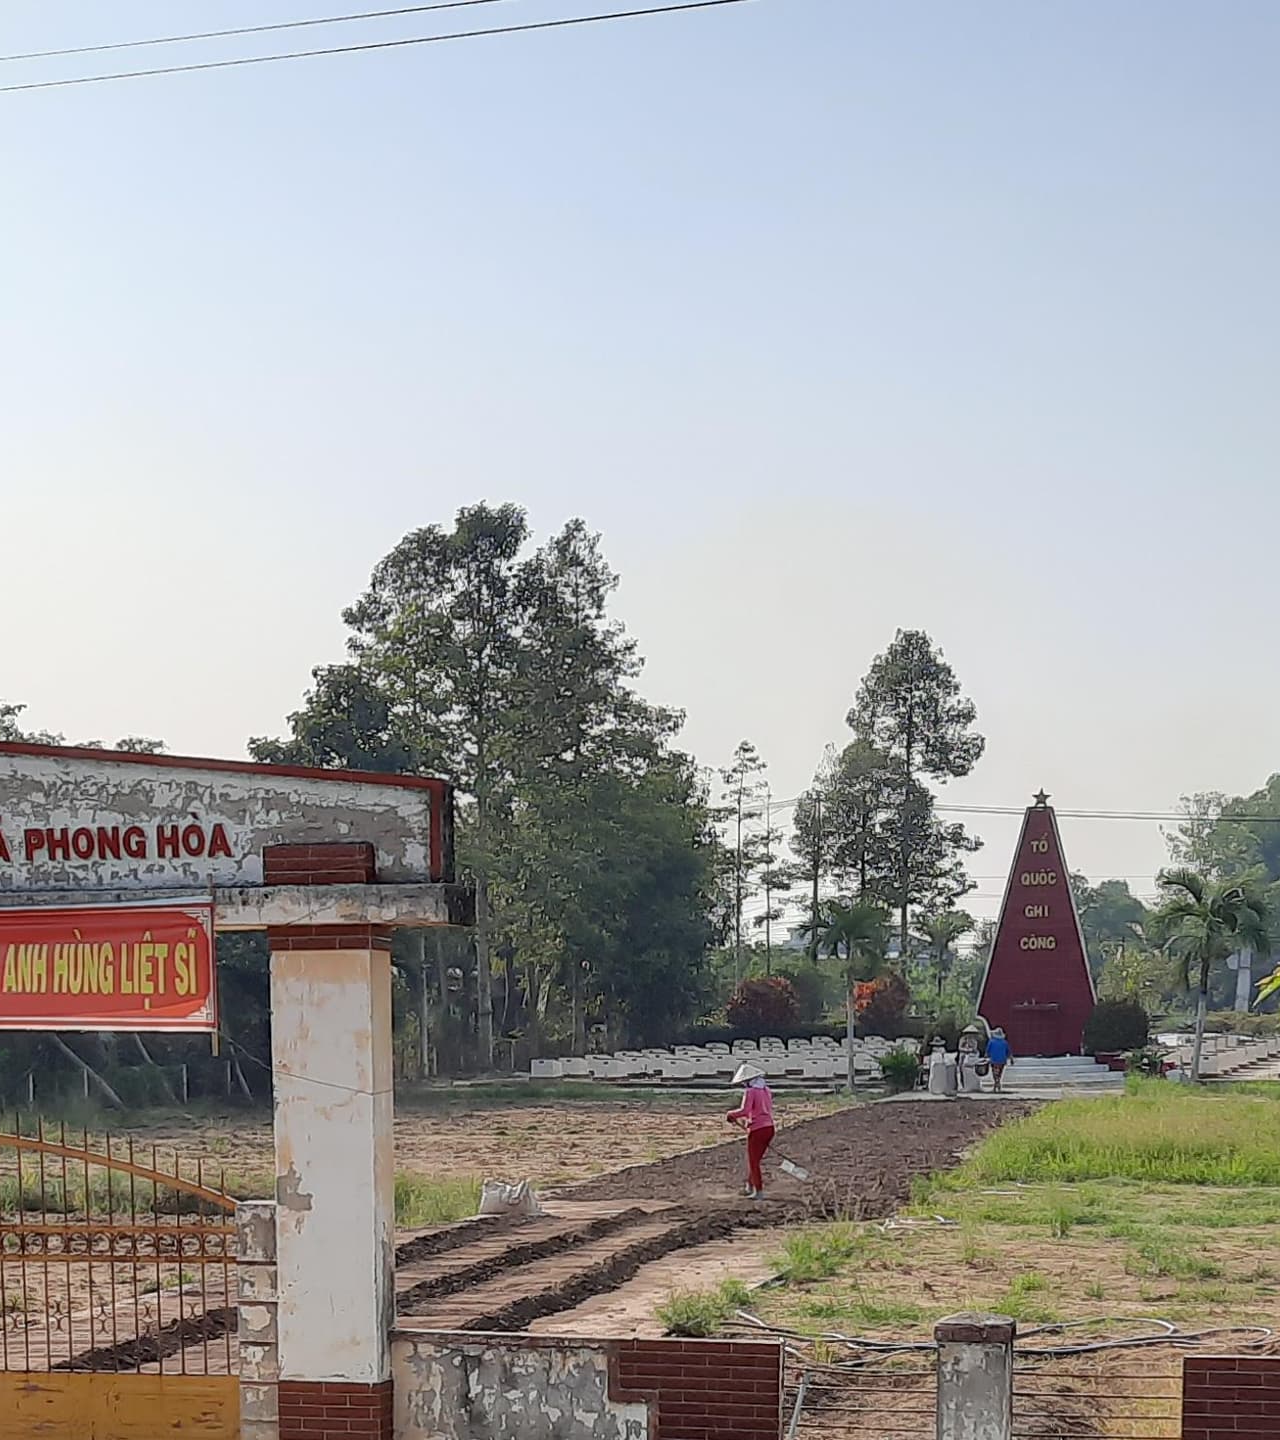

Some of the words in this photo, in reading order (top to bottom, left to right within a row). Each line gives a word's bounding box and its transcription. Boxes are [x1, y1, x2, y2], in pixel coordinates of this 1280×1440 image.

[23, 824, 147, 862] PHONG
[156, 811, 233, 860] HÒA
[1024, 905, 1049, 918] GHI
[1020, 934, 1056, 950] CÔNG
[2, 943, 49, 994] ANH
[52, 929, 114, 994] HÙNG
[120, 930, 169, 1010] LIỆT
